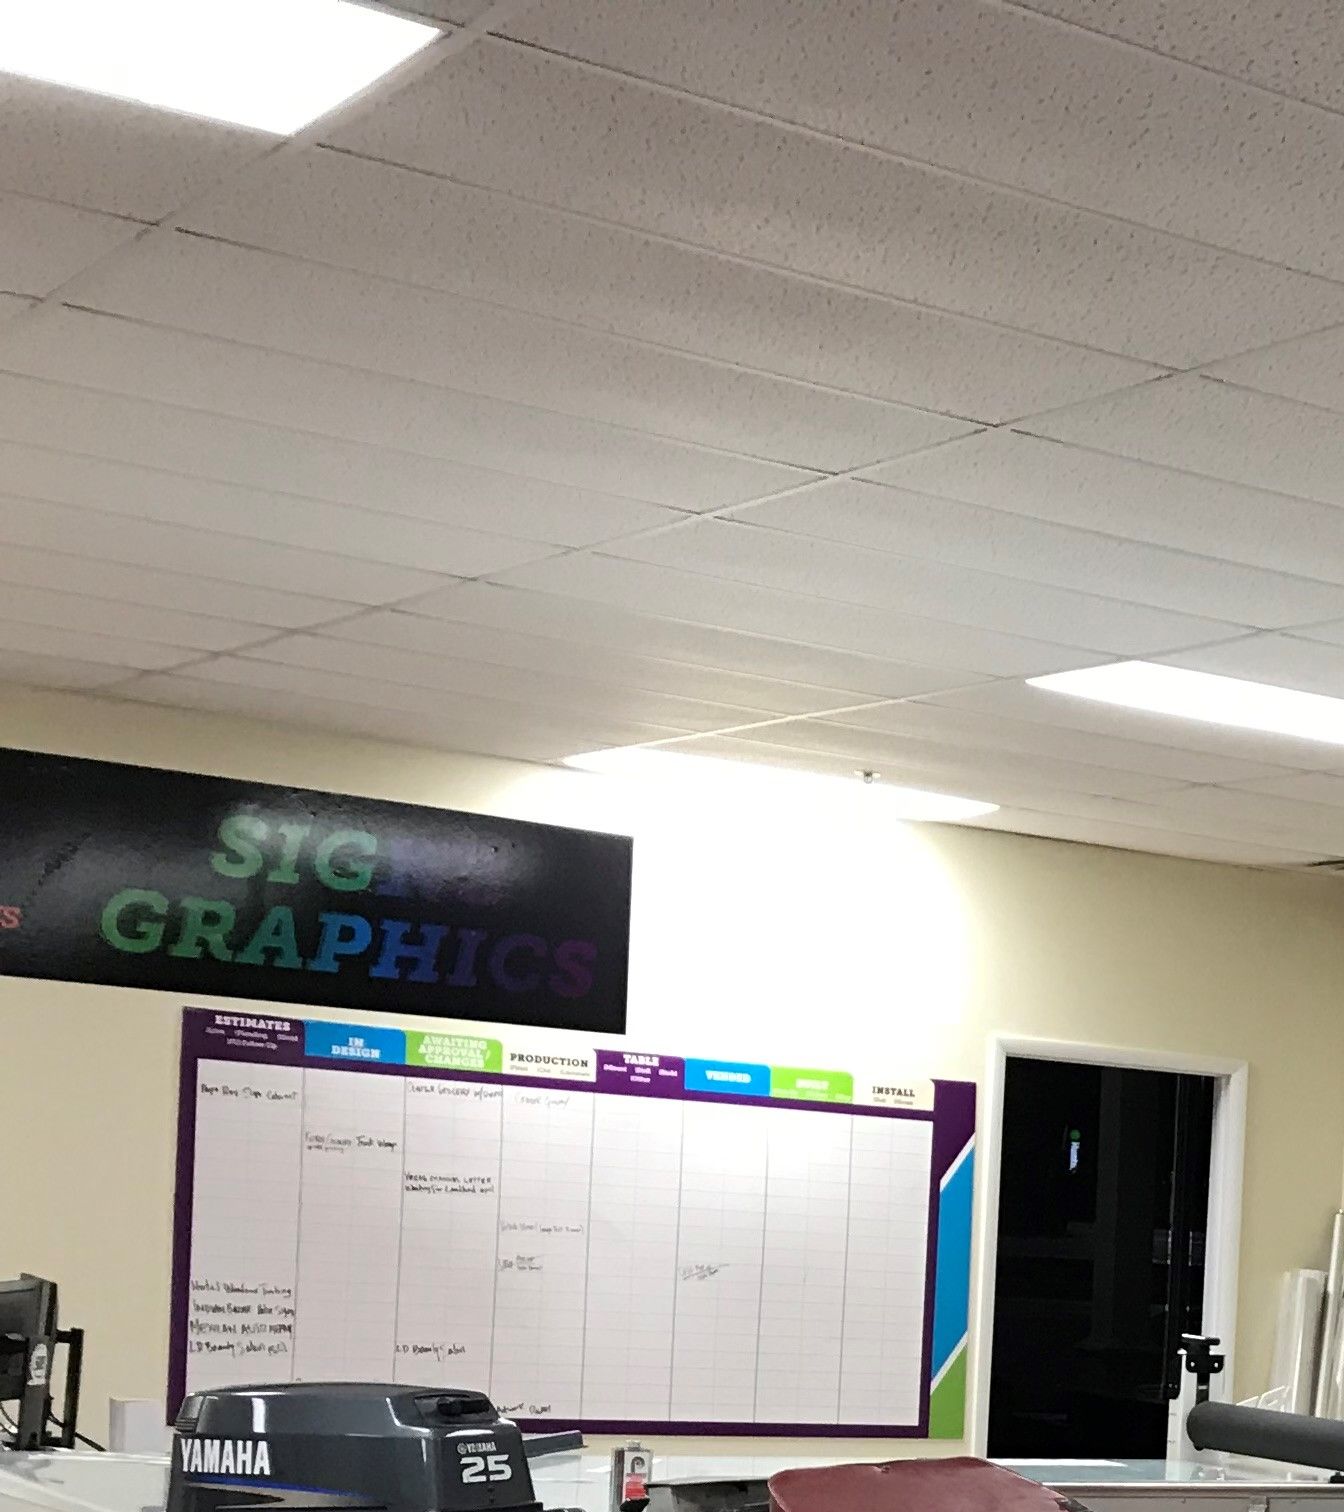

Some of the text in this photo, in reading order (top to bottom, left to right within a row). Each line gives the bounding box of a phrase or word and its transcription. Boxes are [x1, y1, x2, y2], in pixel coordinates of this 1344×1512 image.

[98, 887, 599, 998] GRAPHICS
[214, 1014, 291, 1031] ESTIMATES
[348, 1036, 365, 1048] IN
[423, 1035, 488, 1050] AWAITING
[331, 1044, 381, 1059] DESIGN
[510, 1052, 589, 1068] PRODUCTION
[623, 1053, 660, 1067] TABLE
[872, 1085, 916, 1098] INSTALL
[180, 1437, 271, 1476] YAMAHA
[460, 1454, 513, 1484] 25
